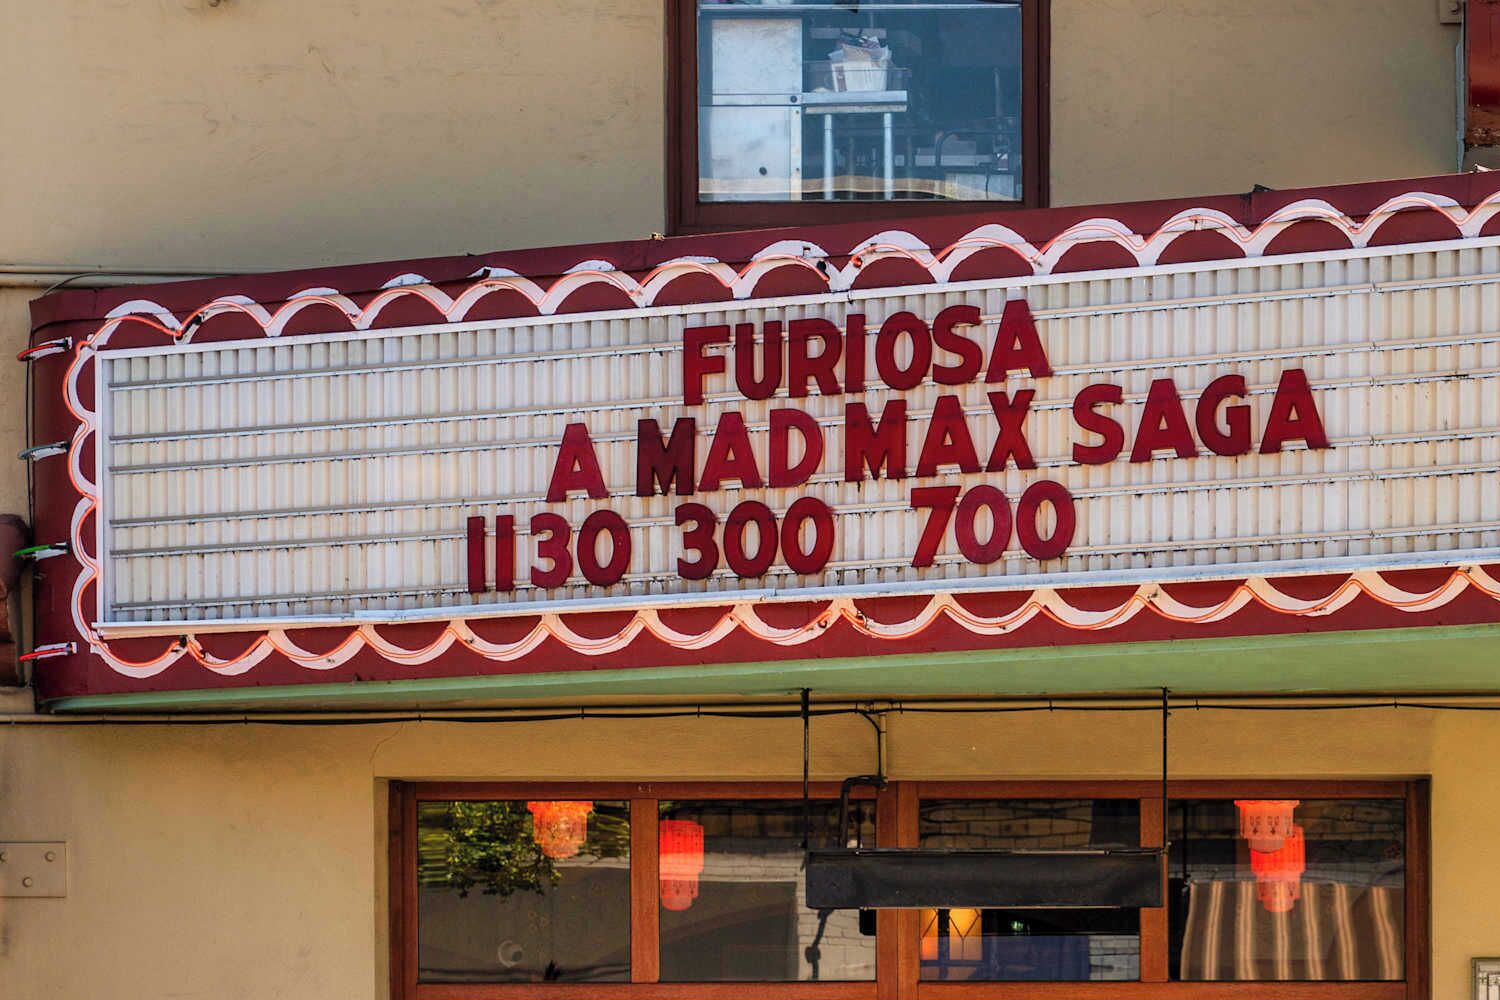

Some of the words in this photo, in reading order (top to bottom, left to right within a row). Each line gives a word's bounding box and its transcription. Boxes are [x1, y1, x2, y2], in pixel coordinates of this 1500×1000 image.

[683, 299, 1053, 406] FURIOSA
[546, 423, 608, 503] A
[636, 408, 824, 497] MAD
[845, 389, 1038, 482] MAX
[1072, 368, 1331, 464] SAGA
[467, 509, 631, 594] 1130
[674, 496, 836, 580] 300
[910, 480, 1076, 568] 700
